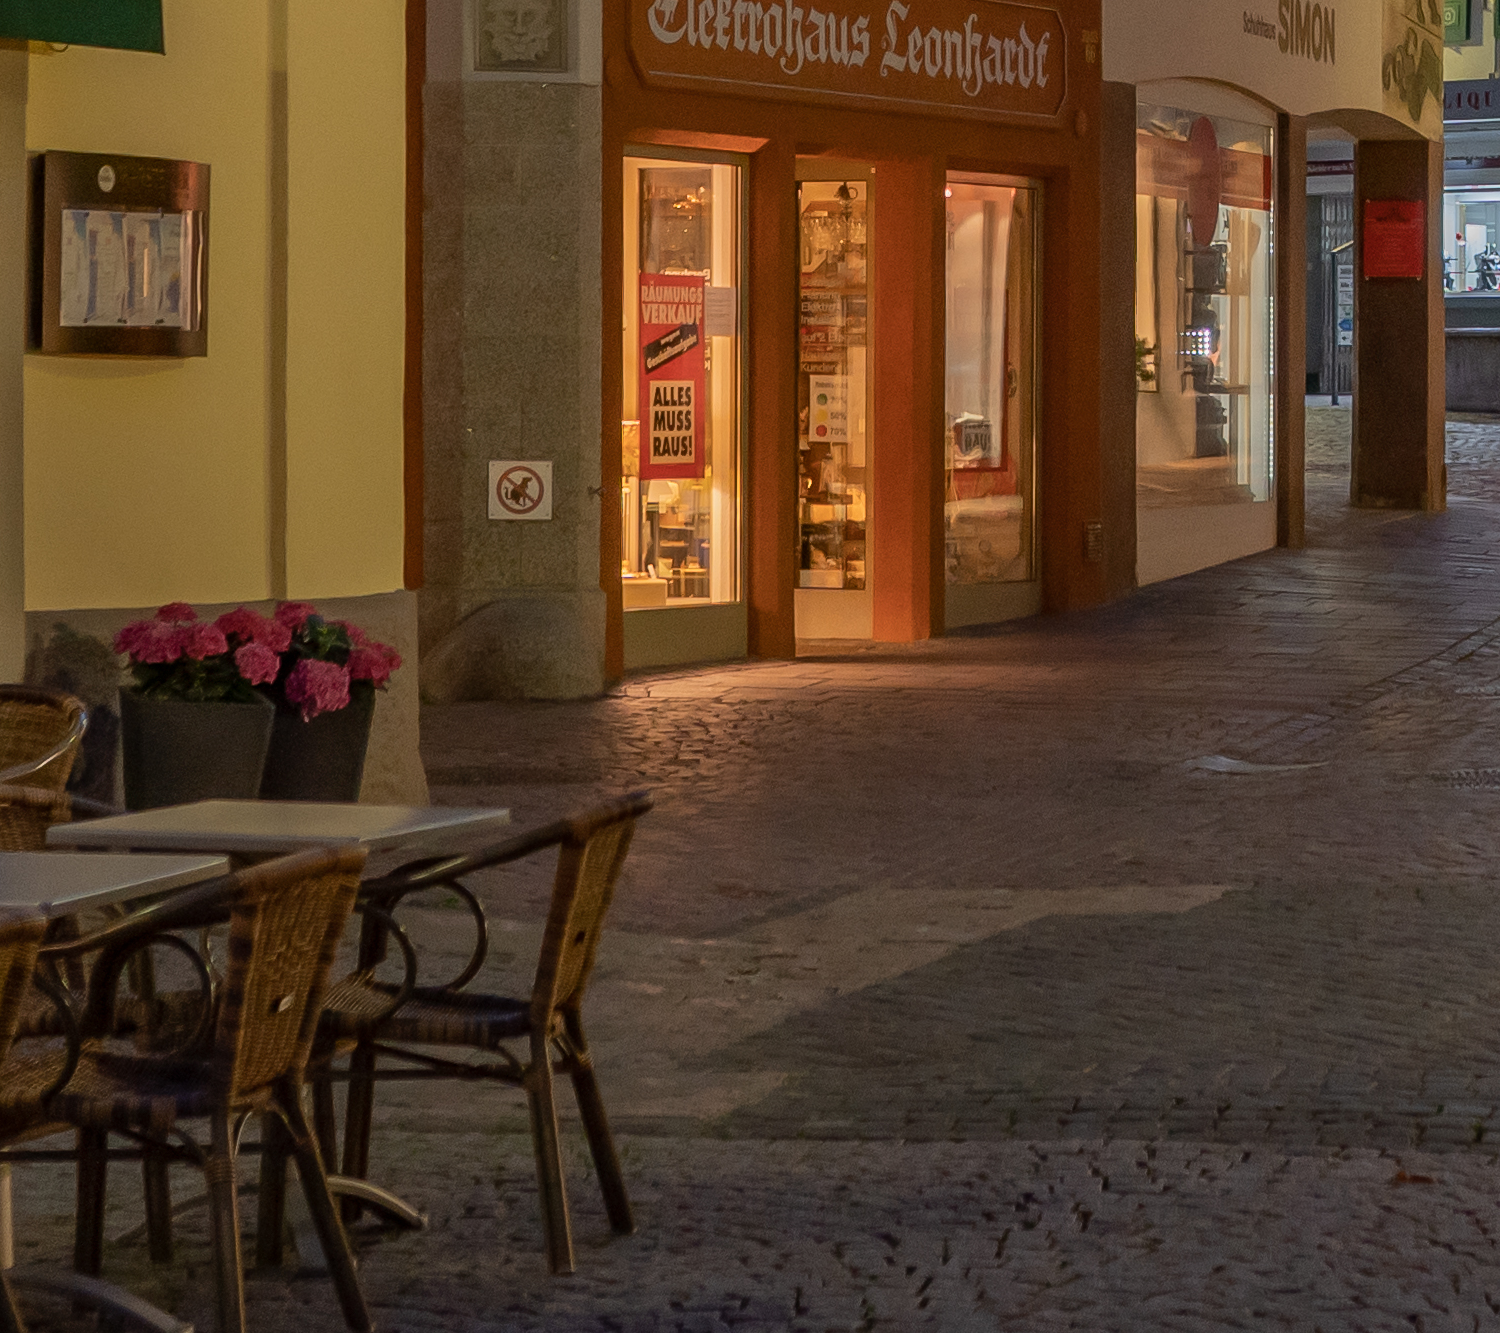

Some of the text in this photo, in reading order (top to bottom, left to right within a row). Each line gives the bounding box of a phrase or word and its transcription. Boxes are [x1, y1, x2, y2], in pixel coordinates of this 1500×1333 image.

[879, 0, 1051, 97] Leonhardt
[641, 280, 703, 303] RÄUMUNGS
[642, 303, 703, 324] VERKAUF
[653, 386, 692, 407] ALLES
[653, 409, 692, 431] MUSS
[653, 436, 693, 457] RAUS!
